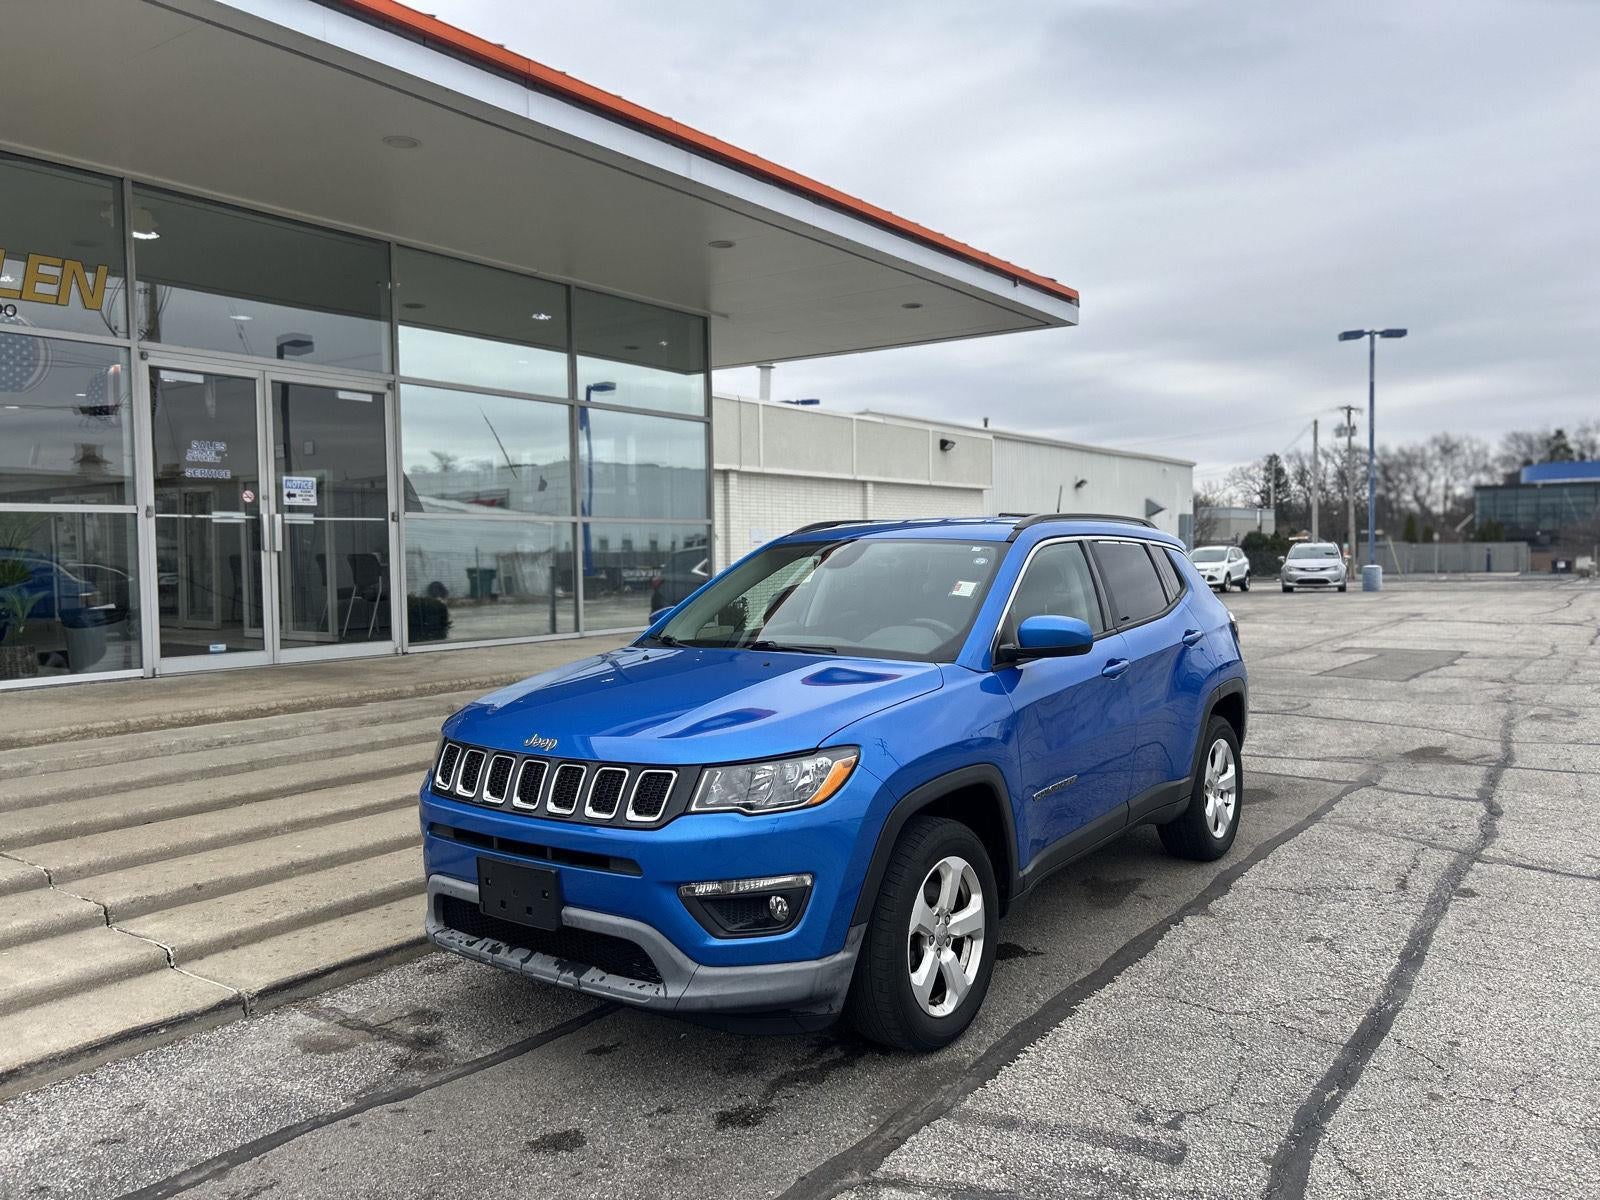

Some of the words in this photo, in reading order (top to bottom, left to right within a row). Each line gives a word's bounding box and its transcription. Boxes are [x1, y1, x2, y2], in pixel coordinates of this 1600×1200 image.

[191, 439, 227, 451] SALES
[185, 467, 231, 479] SERVICE
[286, 480, 313, 489] NOTICE
[524, 733, 558, 751] Jeep
